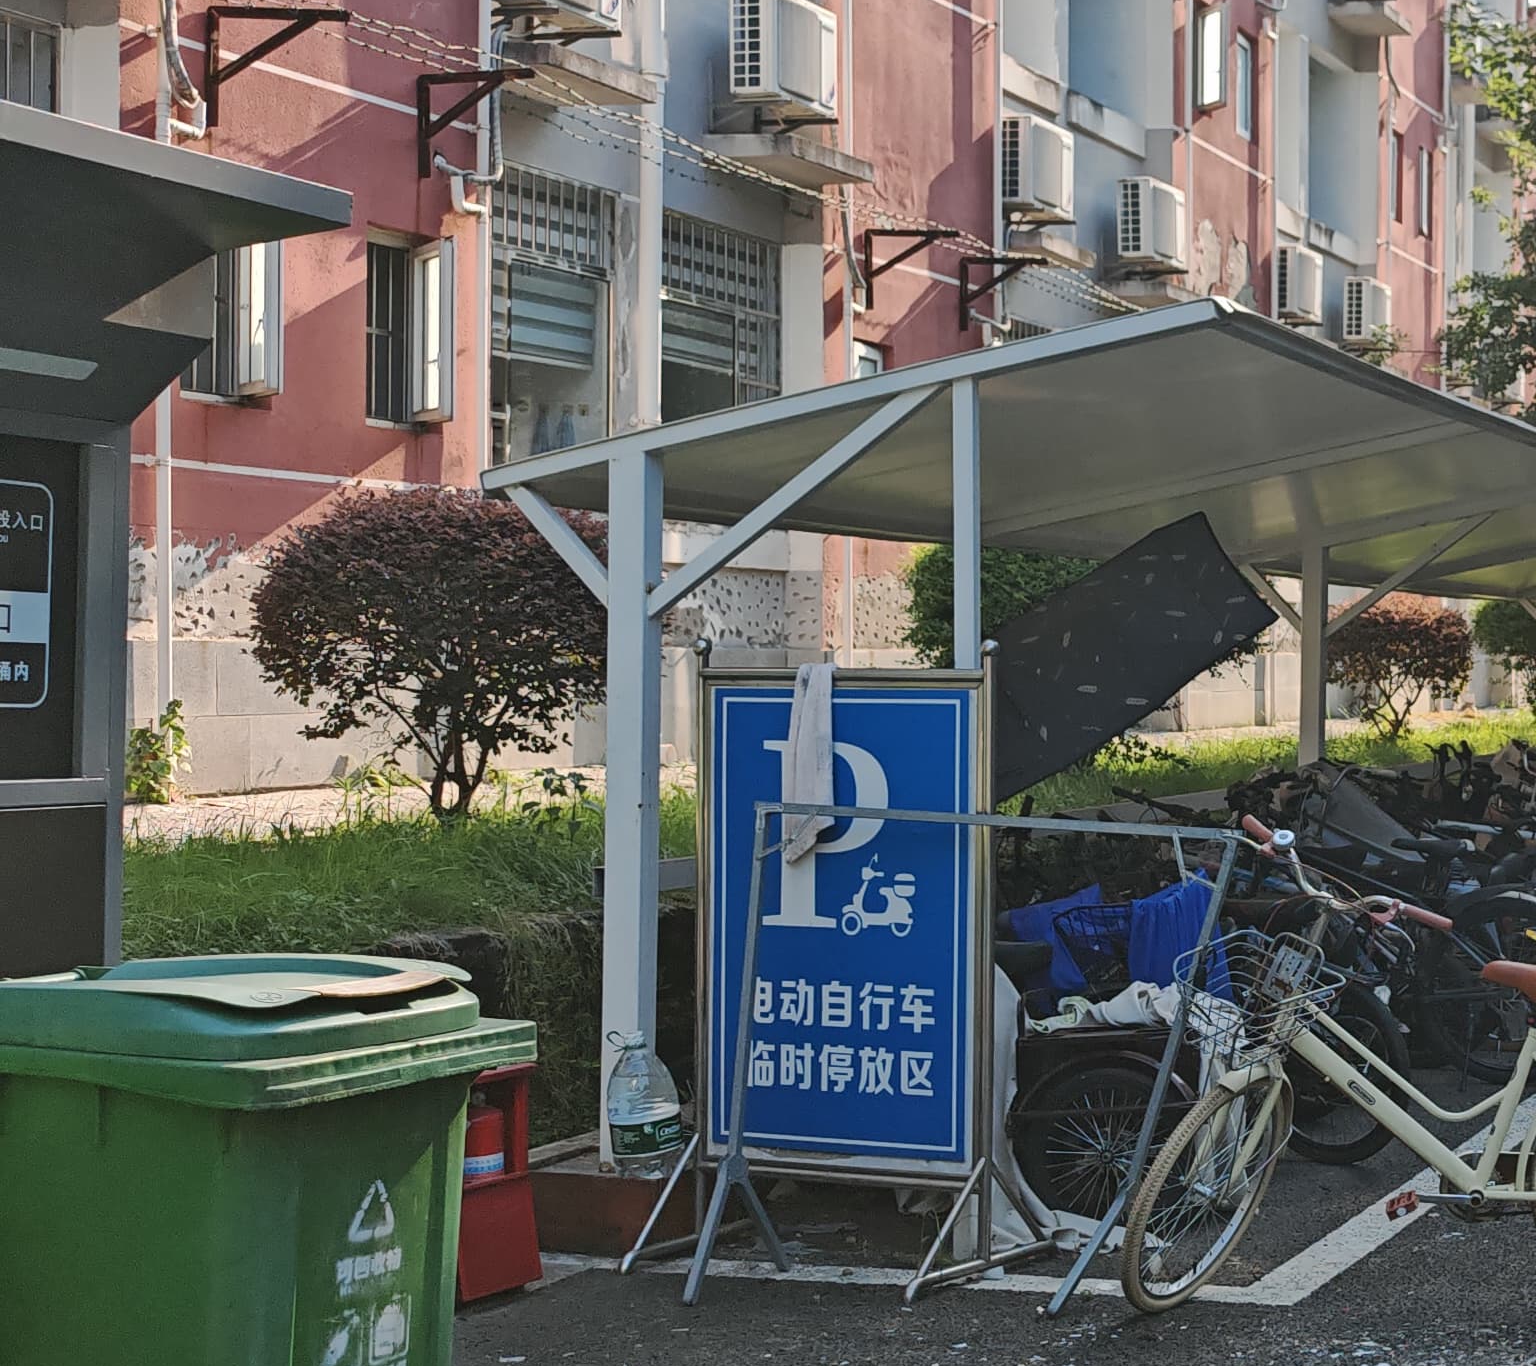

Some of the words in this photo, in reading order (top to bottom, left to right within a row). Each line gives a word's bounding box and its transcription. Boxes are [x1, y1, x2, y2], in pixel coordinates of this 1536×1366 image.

[762, 740, 888, 928] P
[752, 977, 936, 1034] 电动自行车
[747, 1039, 935, 1097] 临时停放区
